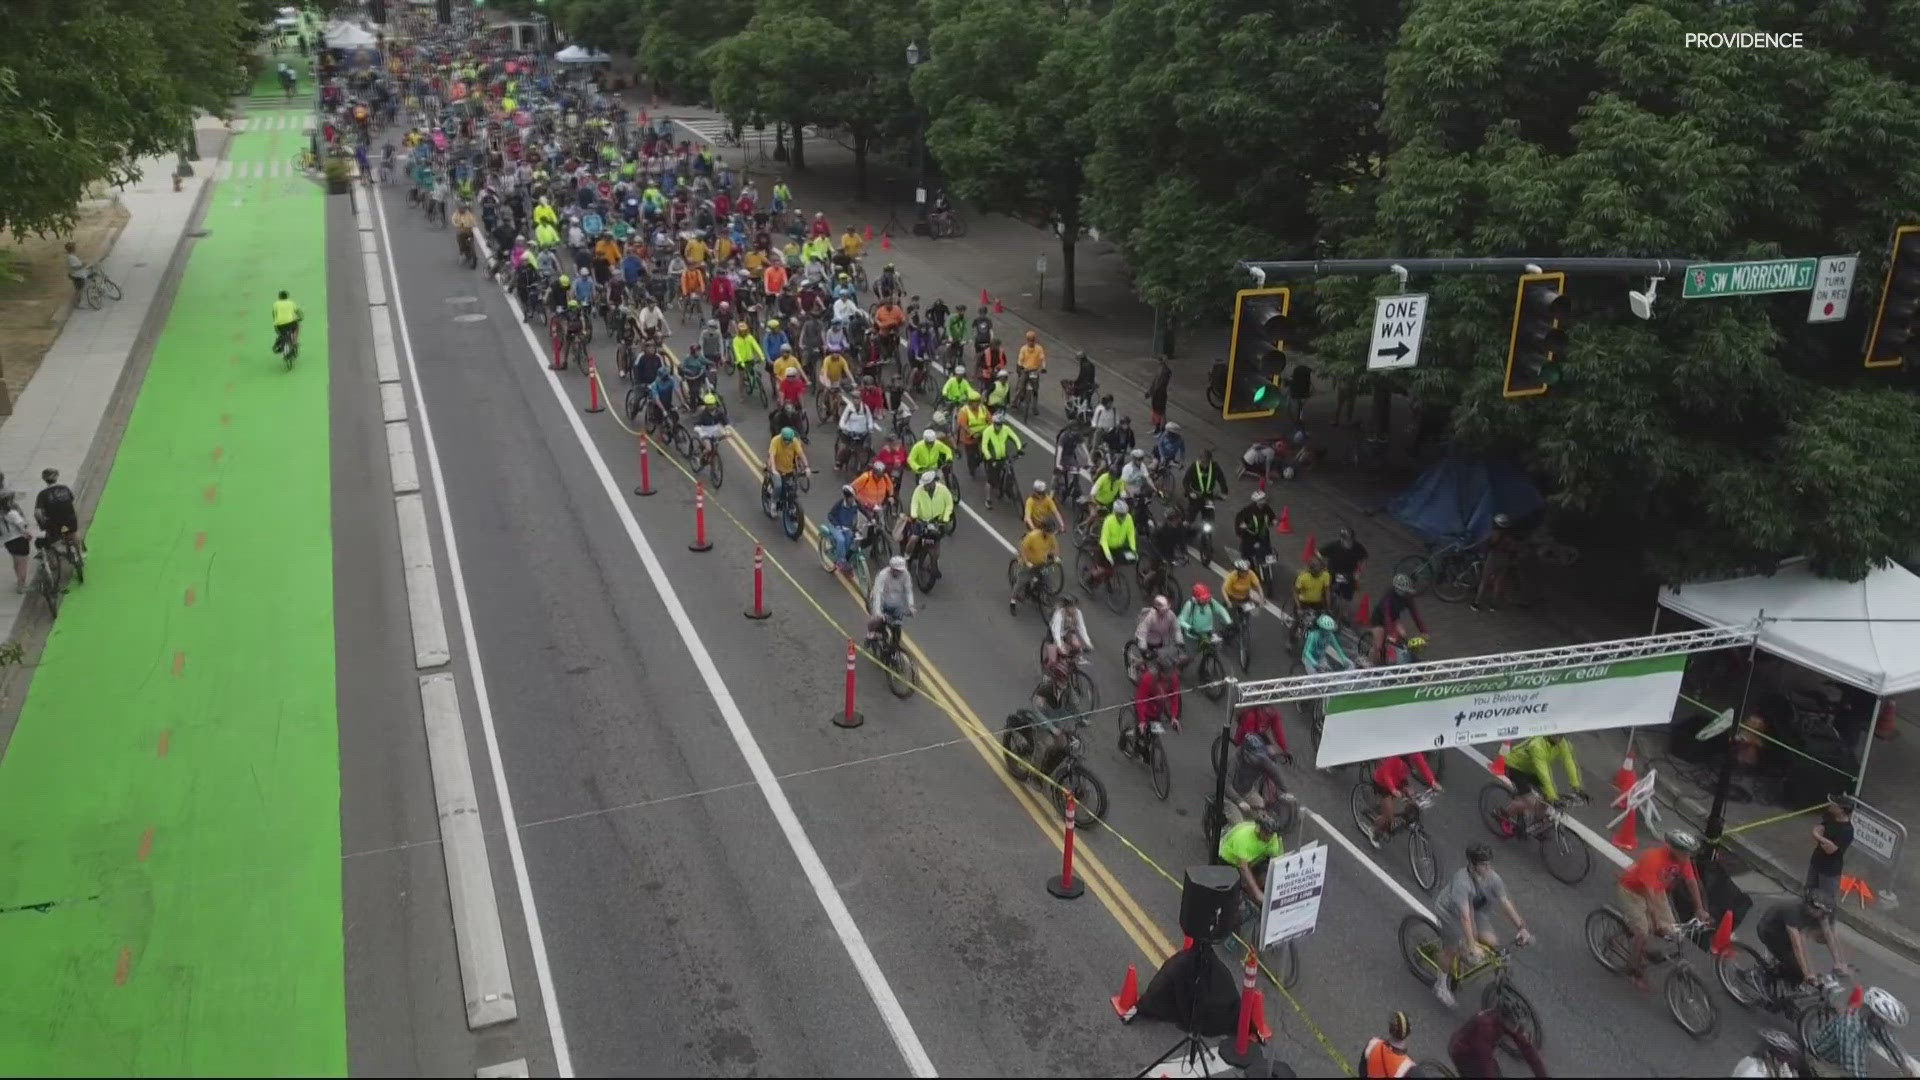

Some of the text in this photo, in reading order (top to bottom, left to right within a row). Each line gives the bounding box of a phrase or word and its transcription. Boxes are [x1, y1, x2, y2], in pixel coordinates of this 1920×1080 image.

[1829, 261, 1846, 273] NO
[1711, 262, 1812, 292] SW MORRISON ST
[1824, 276, 1846, 287] TURN
[1816, 289, 1847, 300] ON RED
[1385, 301, 1418, 319] ONE
[1381, 320, 1416, 339] WAY
[1413, 678, 1508, 699] Providence
[1473, 691, 1540, 707] You Belong at
[1468, 702, 1550, 722] PROVIDENCE
